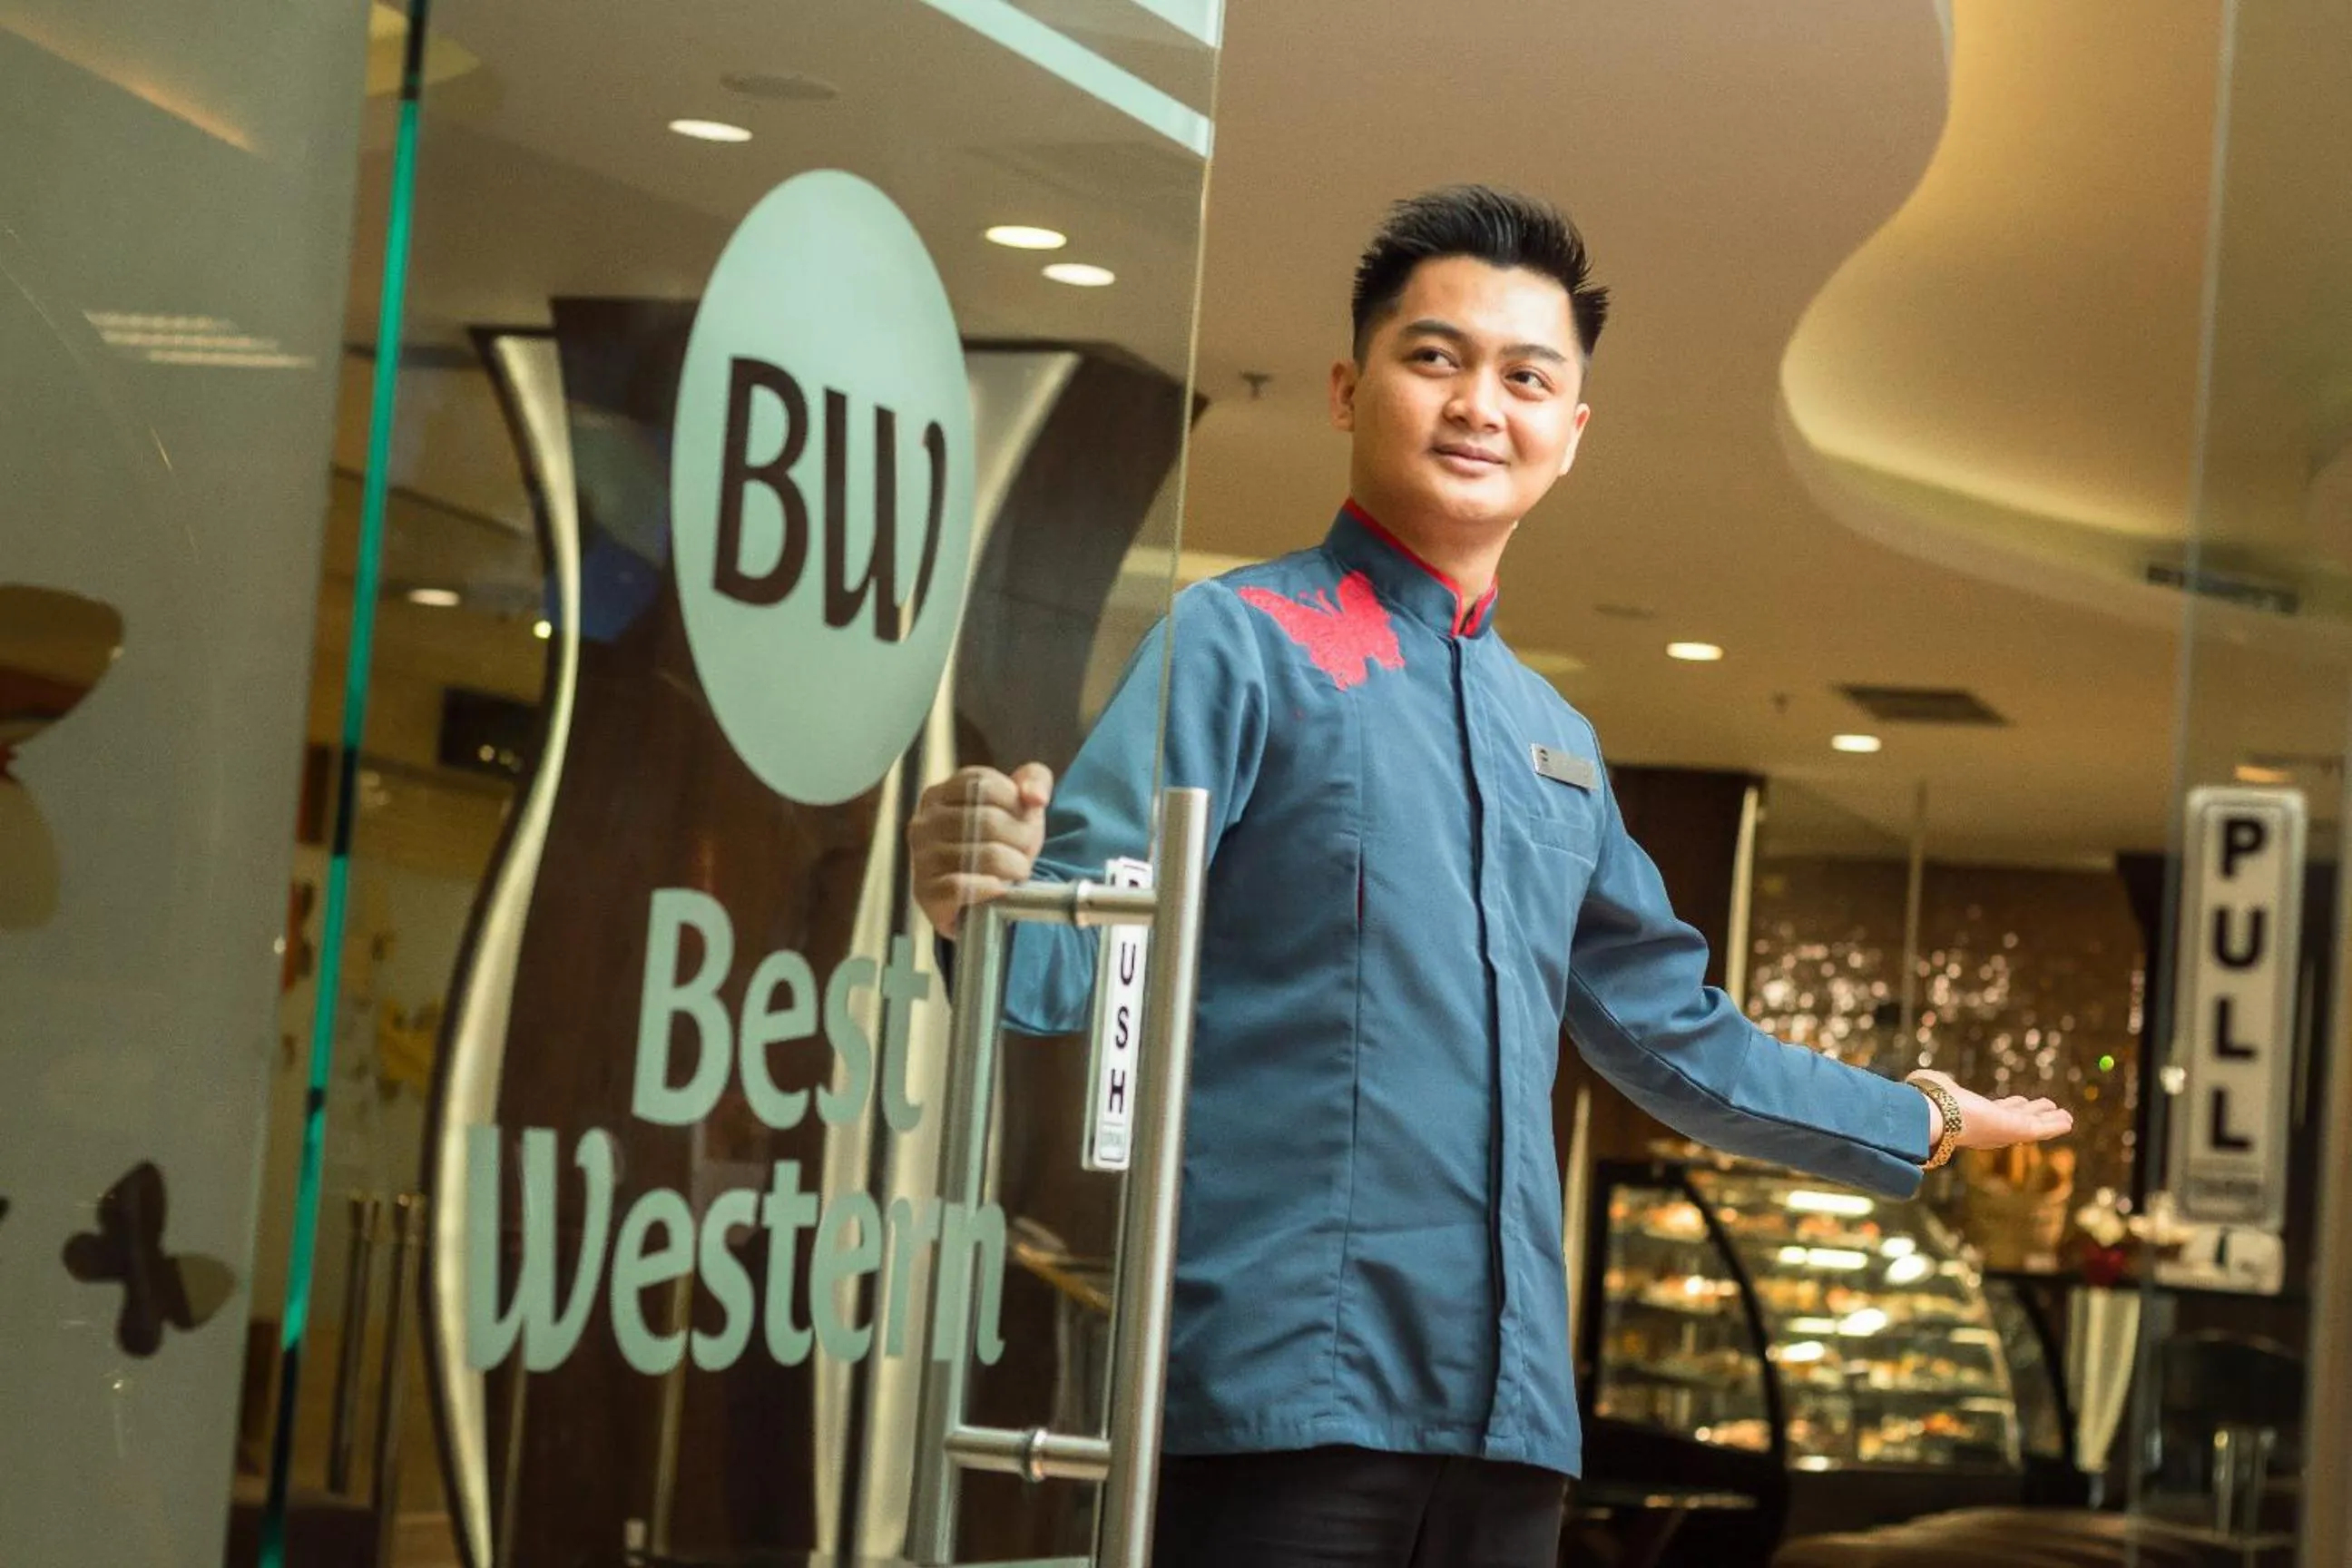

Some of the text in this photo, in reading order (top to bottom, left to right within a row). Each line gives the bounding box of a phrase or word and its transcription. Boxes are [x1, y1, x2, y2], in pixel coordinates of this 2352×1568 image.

[711, 355, 947, 644] BW
[632, 888, 930, 1132] Best
[1108, 878, 1139, 1115] USH
[2209, 816, 2269, 1153] PULL
[465, 1125, 1007, 1376] Western
